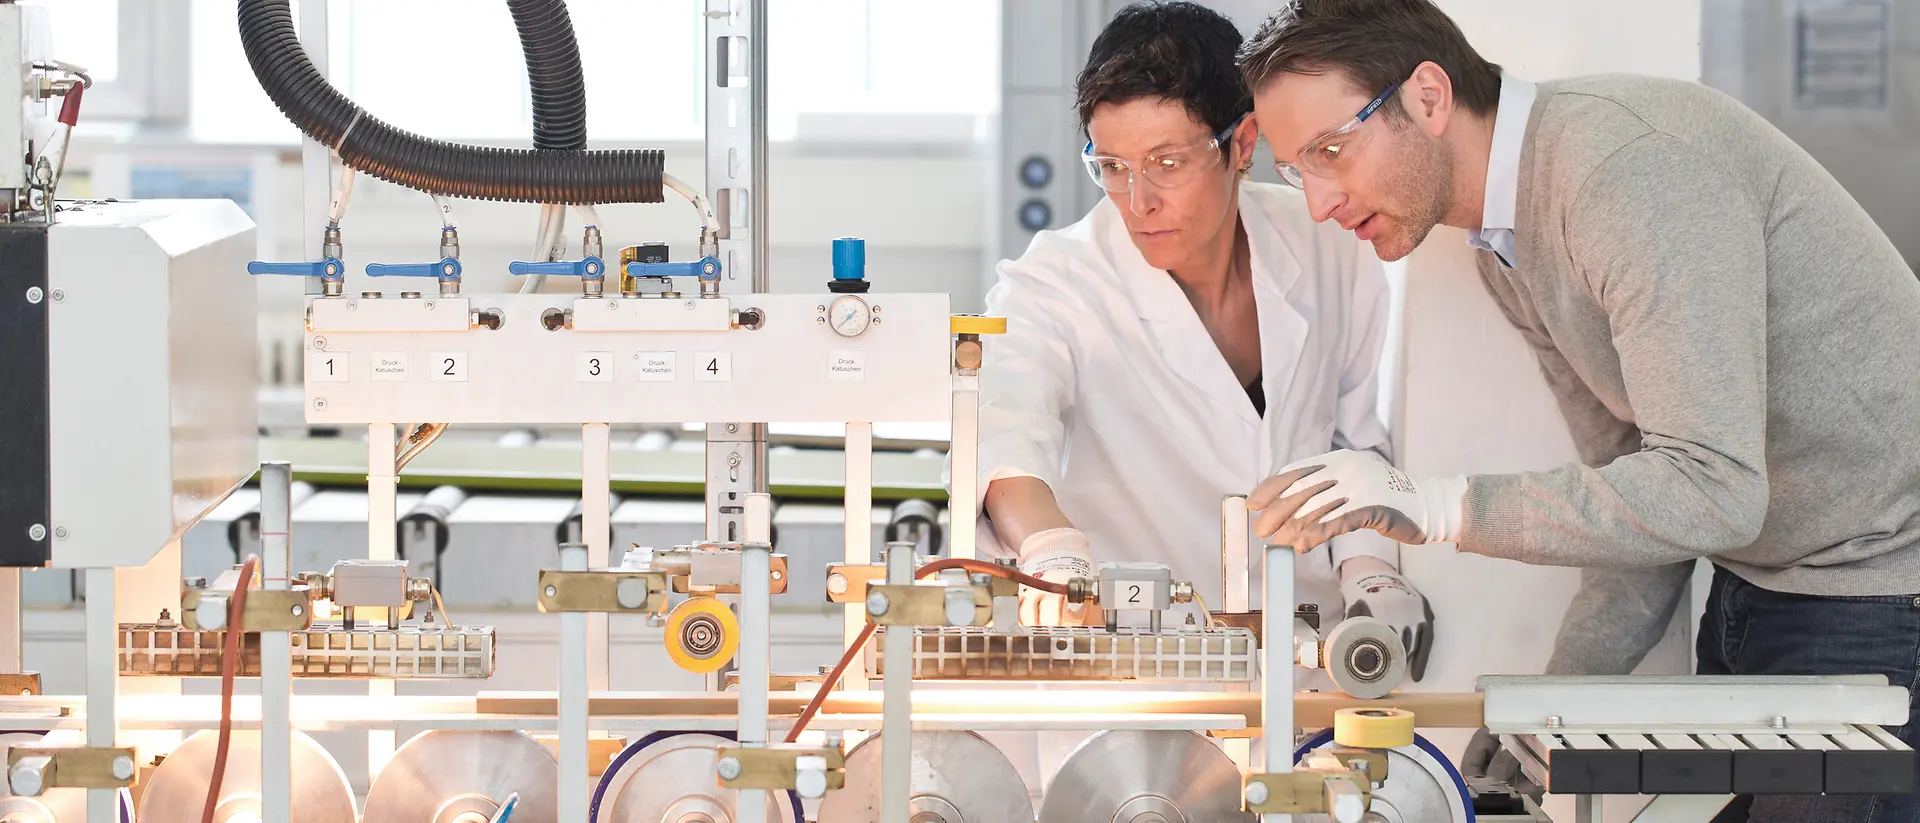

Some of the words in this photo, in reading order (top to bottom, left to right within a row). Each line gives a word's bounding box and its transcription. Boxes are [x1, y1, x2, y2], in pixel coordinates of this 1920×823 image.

[443, 204, 450, 213] 2
[326, 358, 334, 376] 1
[443, 358, 456, 376] 2
[589, 358, 601, 376] 3
[706, 358, 719, 375] 4
[1128, 585, 1140, 603] 2
